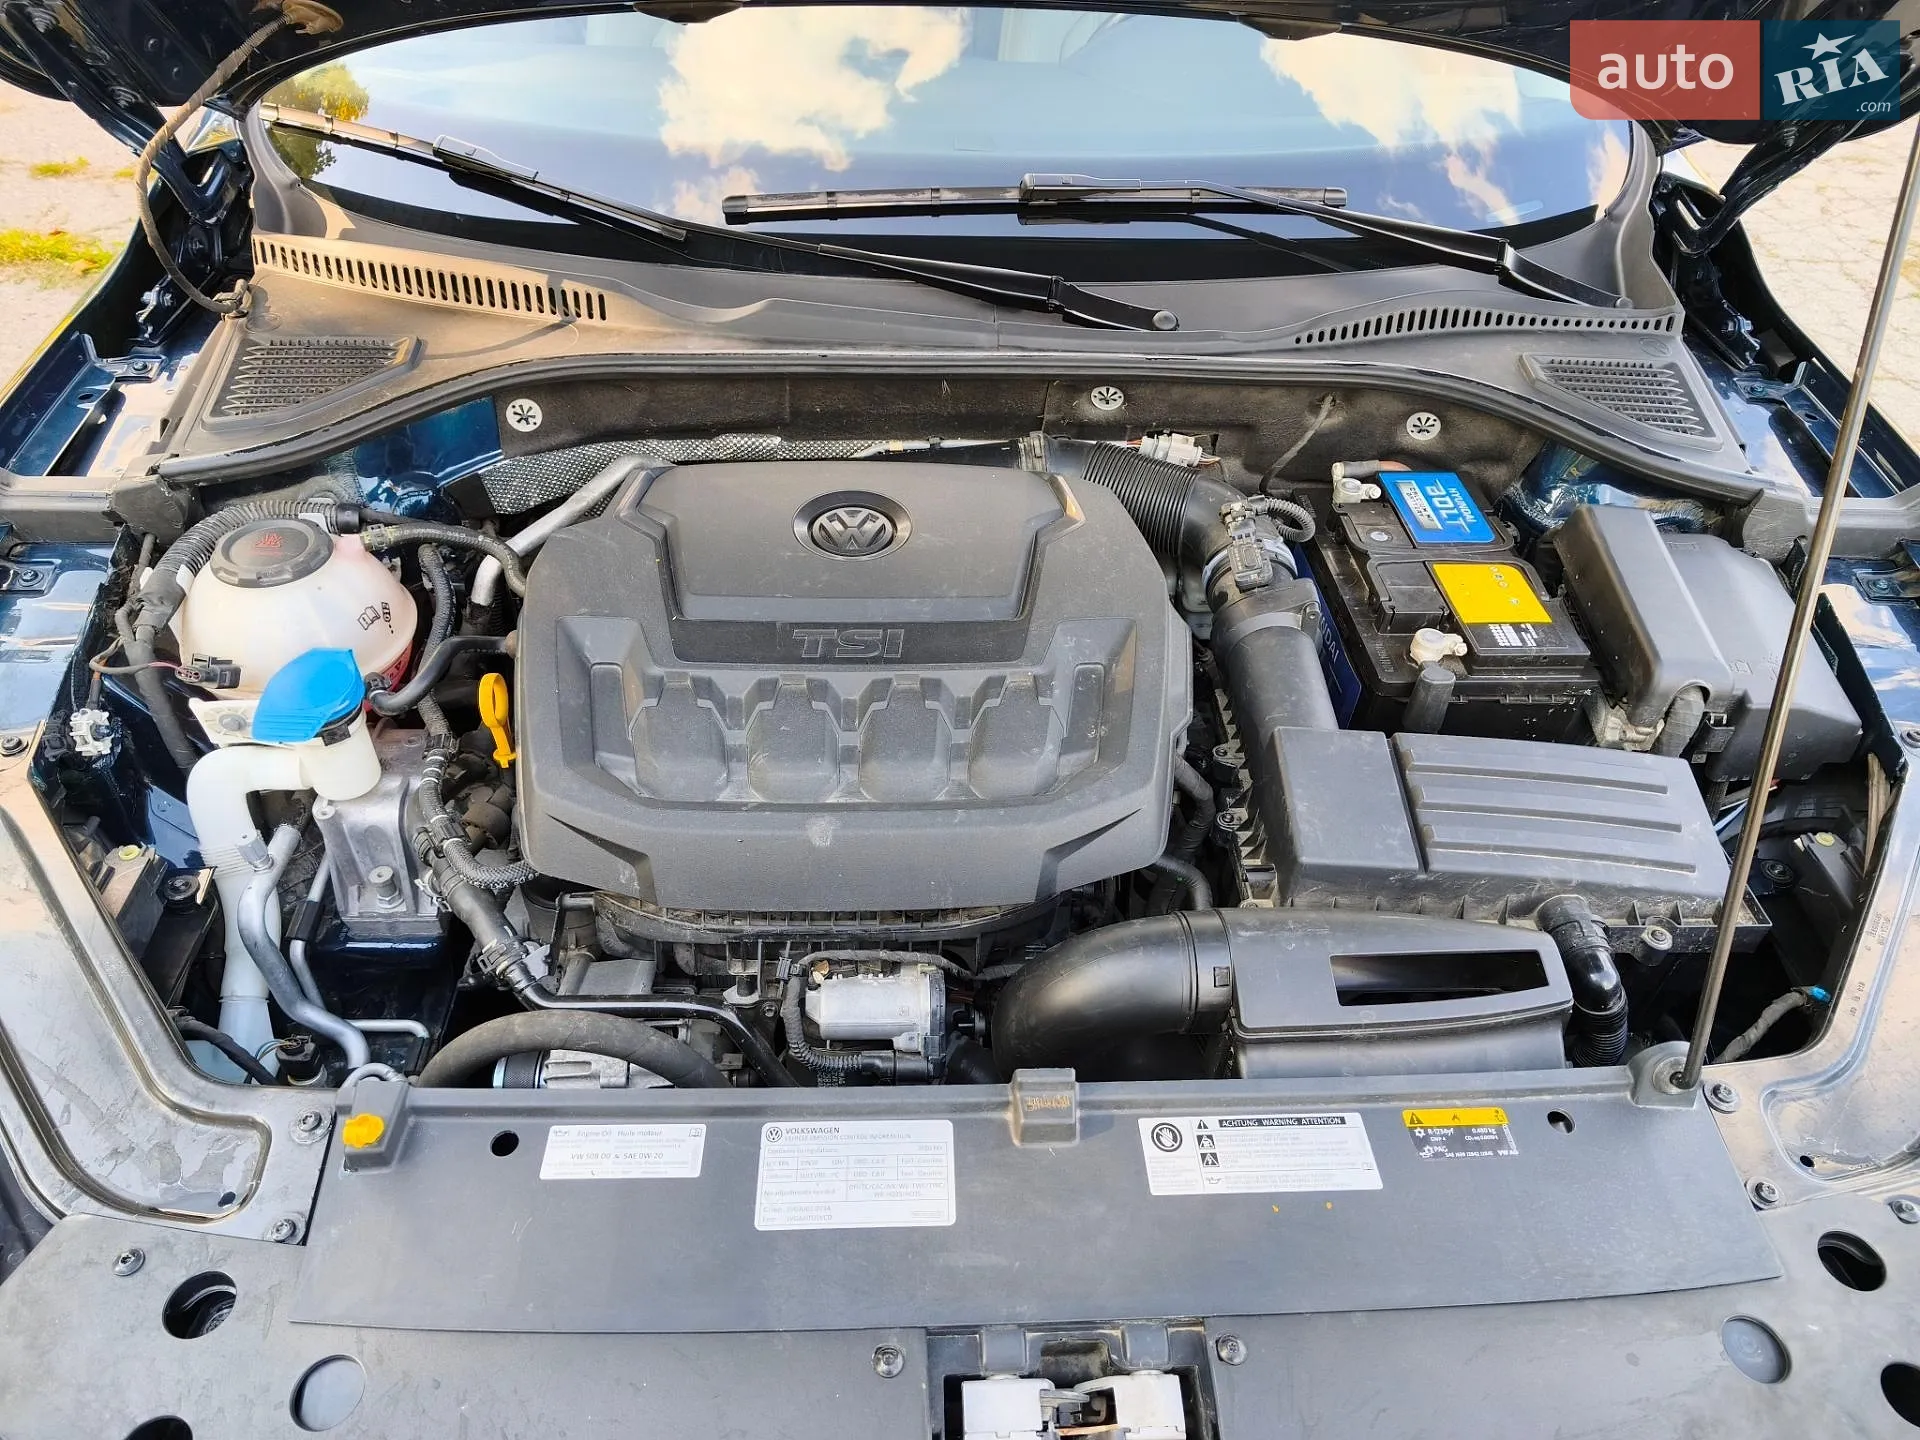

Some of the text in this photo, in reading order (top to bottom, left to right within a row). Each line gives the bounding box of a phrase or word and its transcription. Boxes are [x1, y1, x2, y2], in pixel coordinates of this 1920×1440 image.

[1425, 478, 1471, 533] BOLT
[1448, 487, 1477, 522] HYUNDAI
[793, 628, 905, 658] TSI
[1222, 1117, 1341, 1127] ACHTUNG WARNING ATTENTION
[577, 1129, 600, 1138] Engine
[617, 1129, 635, 1137] Huile
[785, 1126, 840, 1135] VOLKSWAGEN
[571, 1152, 584, 1160] VW
[623, 1152, 639, 1160] SAE
